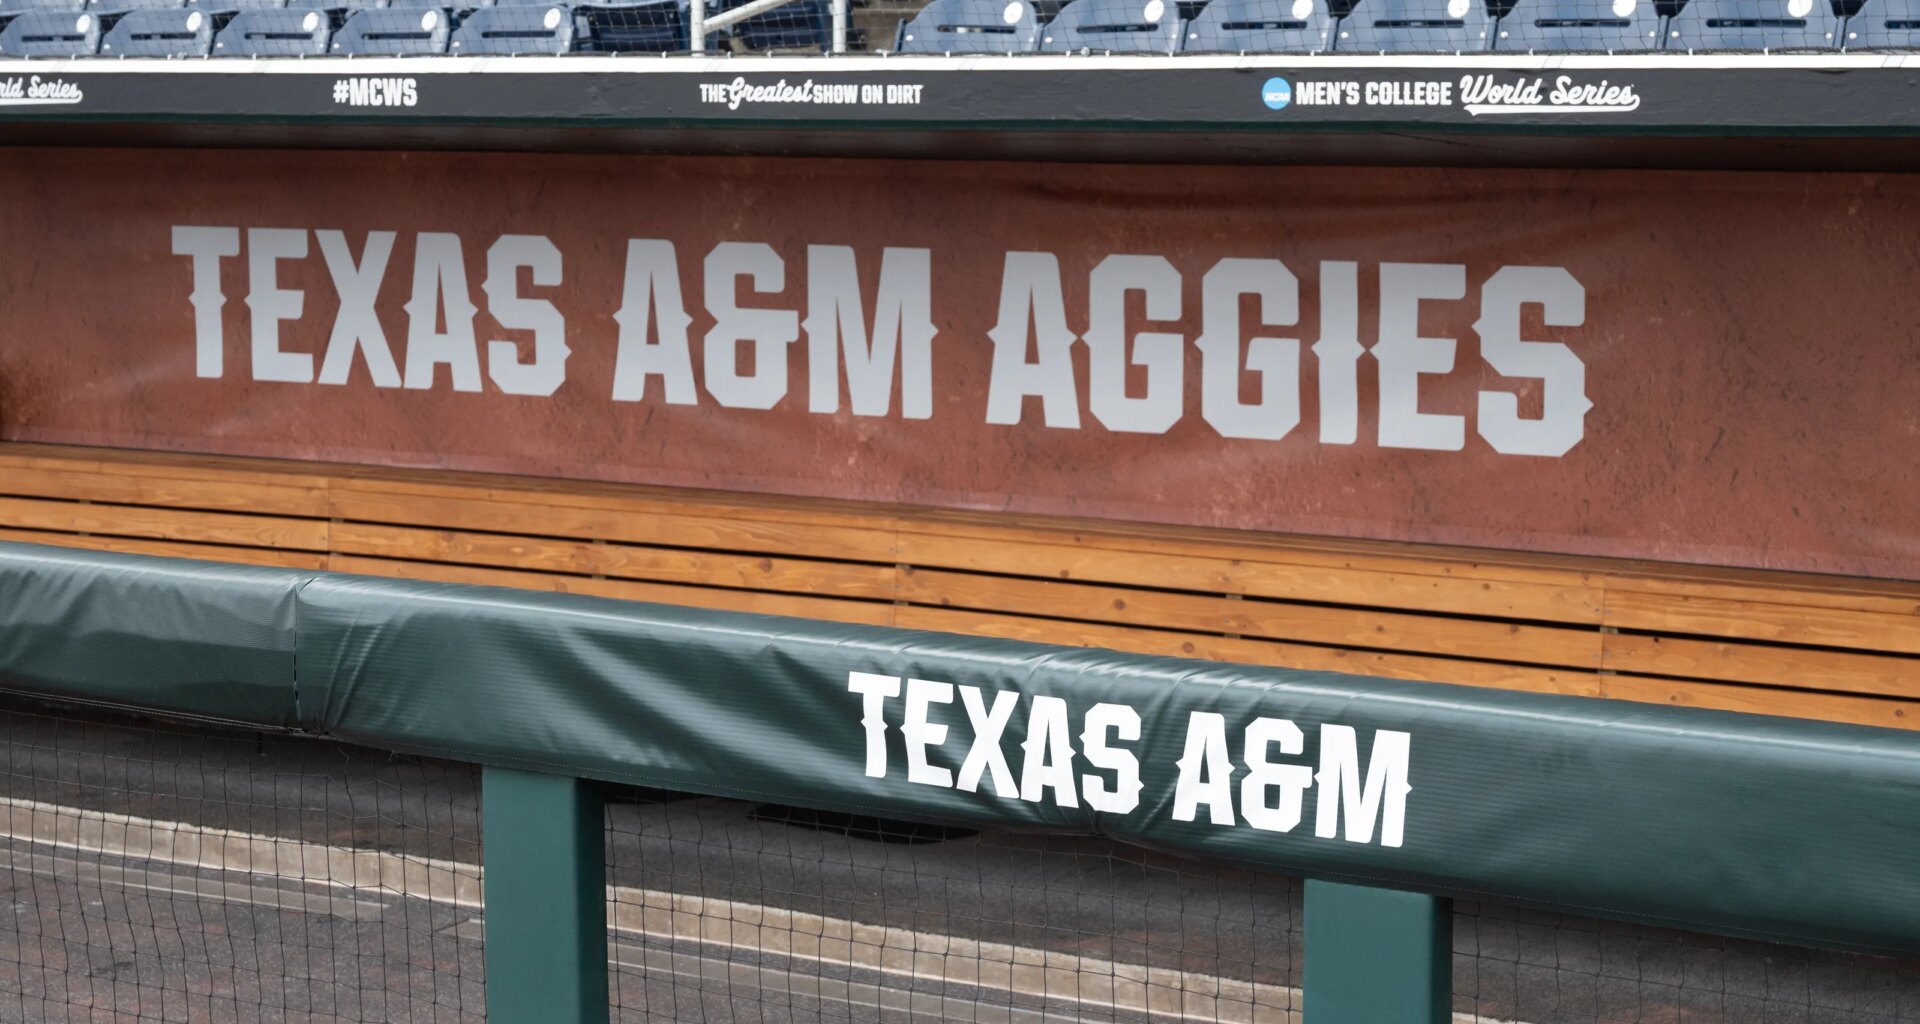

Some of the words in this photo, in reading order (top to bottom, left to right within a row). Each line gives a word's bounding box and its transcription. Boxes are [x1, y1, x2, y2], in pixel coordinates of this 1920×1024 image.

[0, 77, 25, 99] rld
[28, 75, 80, 99] Series
[333, 78, 418, 107] #MCWS
[699, 83, 728, 103] THE
[727, 76, 814, 110] Greatest
[813, 84, 858, 104] SHOW
[861, 84, 884, 104] ON
[887, 84, 924, 104] DIRT
[1296, 81, 1361, 105] MEN'S
[1365, 81, 1453, 106] COLLEGE
[1460, 74, 1544, 105] World
[1549, 75, 1634, 105] Series
[172, 225, 572, 397] TEXAS
[611, 239, 939, 420] A&M
[986, 251, 1594, 458] AGGIES
[848, 670, 1145, 815] TEXAS
[1172, 710, 1413, 848] A&M
